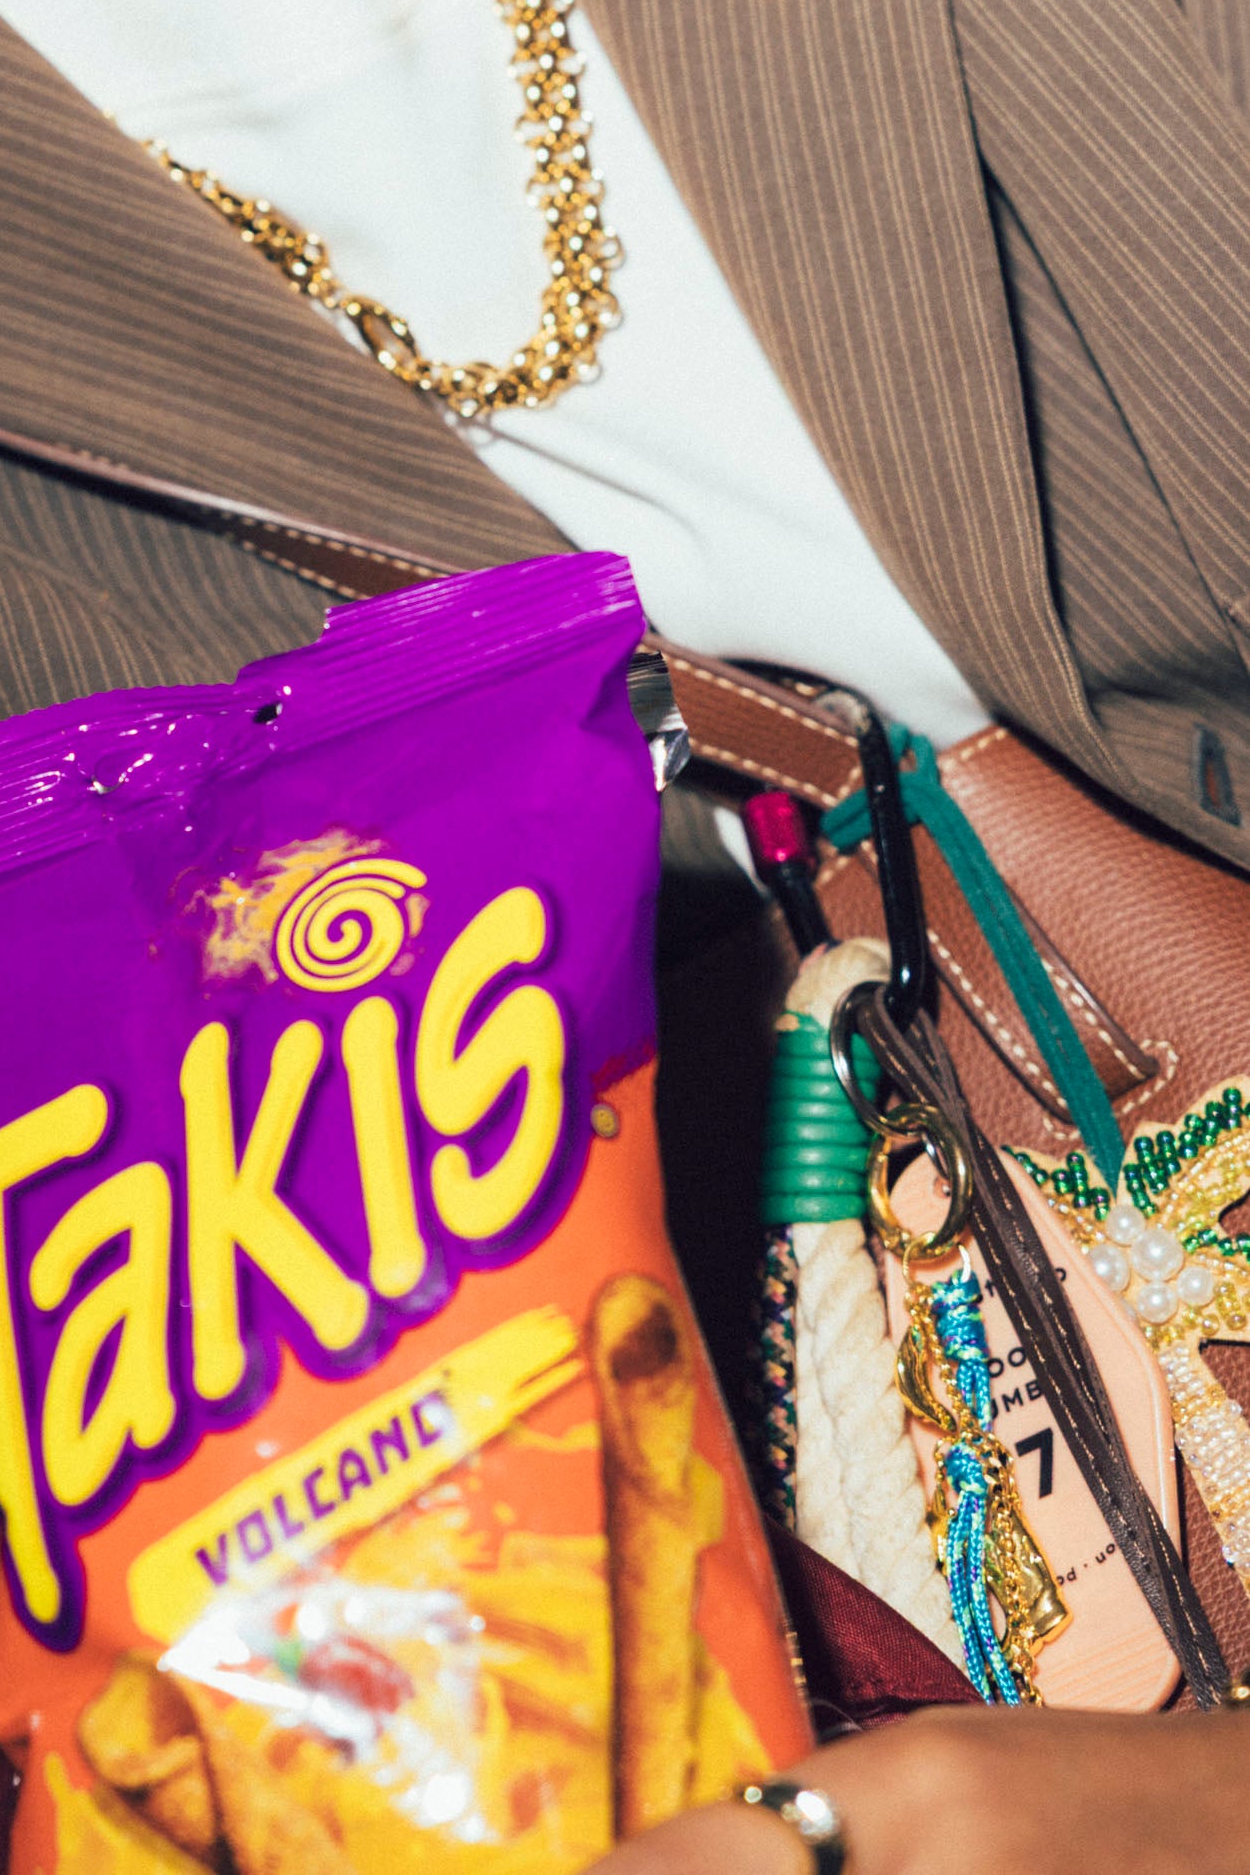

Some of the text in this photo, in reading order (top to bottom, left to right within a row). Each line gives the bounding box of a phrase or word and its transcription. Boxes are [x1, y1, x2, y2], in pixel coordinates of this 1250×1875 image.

[986, 1347, 1027, 1379] OO
[194, 1387, 448, 1588] VOLCANO
[1014, 1427, 1054, 1499] 7
